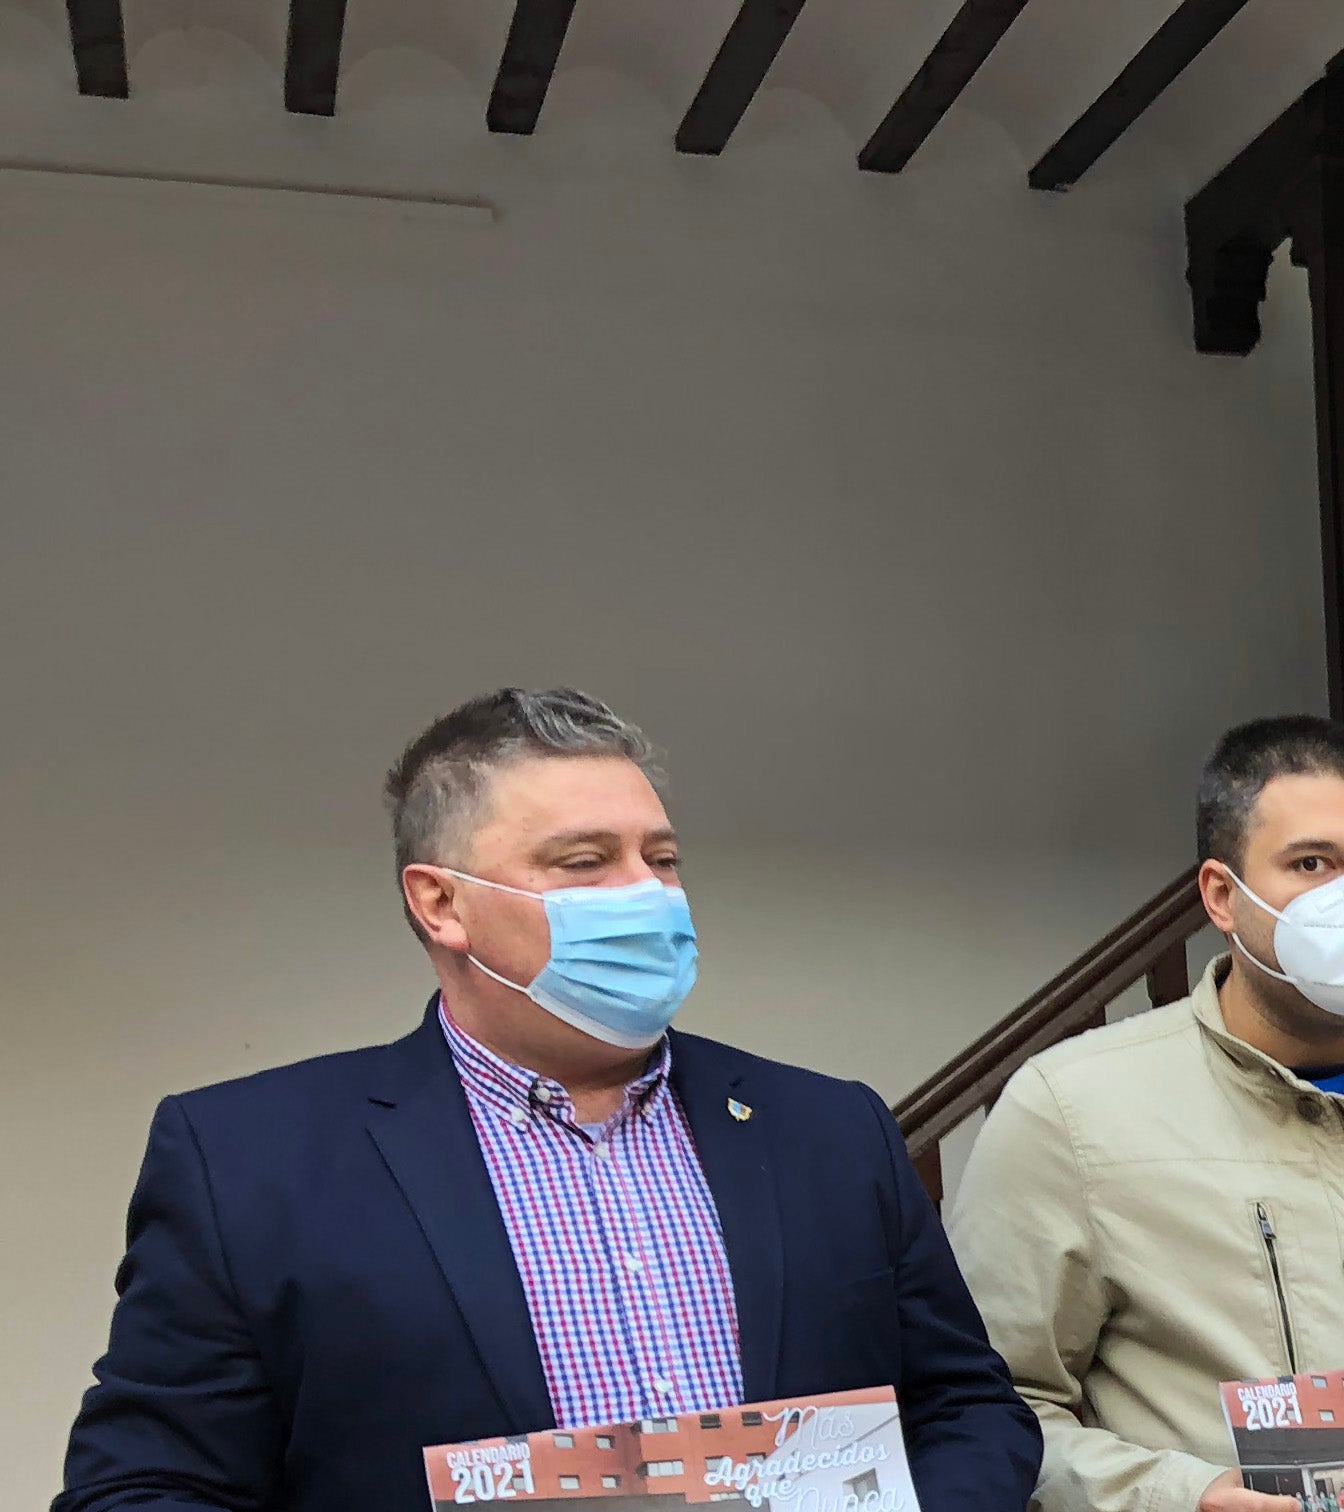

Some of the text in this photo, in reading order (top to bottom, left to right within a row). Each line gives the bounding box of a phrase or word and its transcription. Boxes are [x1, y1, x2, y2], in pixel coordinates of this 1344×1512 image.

[1237, 1382, 1298, 1401] CALENDARIO
[762, 1405, 856, 1450] Más
[1242, 1395, 1303, 1431] 2021
[446, 1441, 531, 1469] CALENDARIO
[704, 1441, 892, 1490] Agradecidos
[451, 1459, 535, 1505] 2021
[744, 1476, 800, 1508] que
